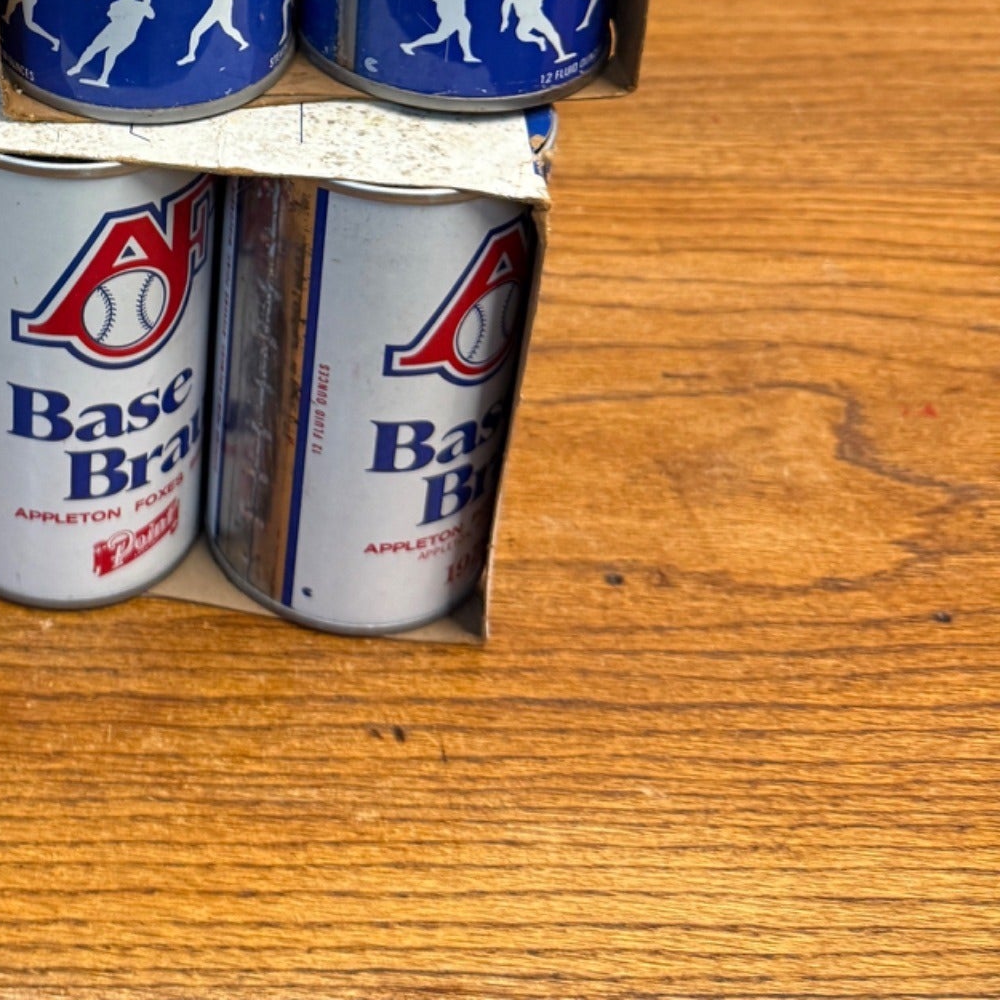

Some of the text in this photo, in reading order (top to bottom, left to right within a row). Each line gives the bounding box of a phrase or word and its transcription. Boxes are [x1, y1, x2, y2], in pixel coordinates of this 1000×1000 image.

[540, 71, 553, 84] 12
[555, 61, 579, 81] FLUID
[7, 366, 194, 443] Base
[312, 363, 331, 455] 12 FLUID OUNCES
[364, 401, 503, 473] Bas
[63, 418, 200, 502] Bra
[14, 471, 185, 525] APPLETON FOXES
[364, 523, 464, 555] APPLETON
